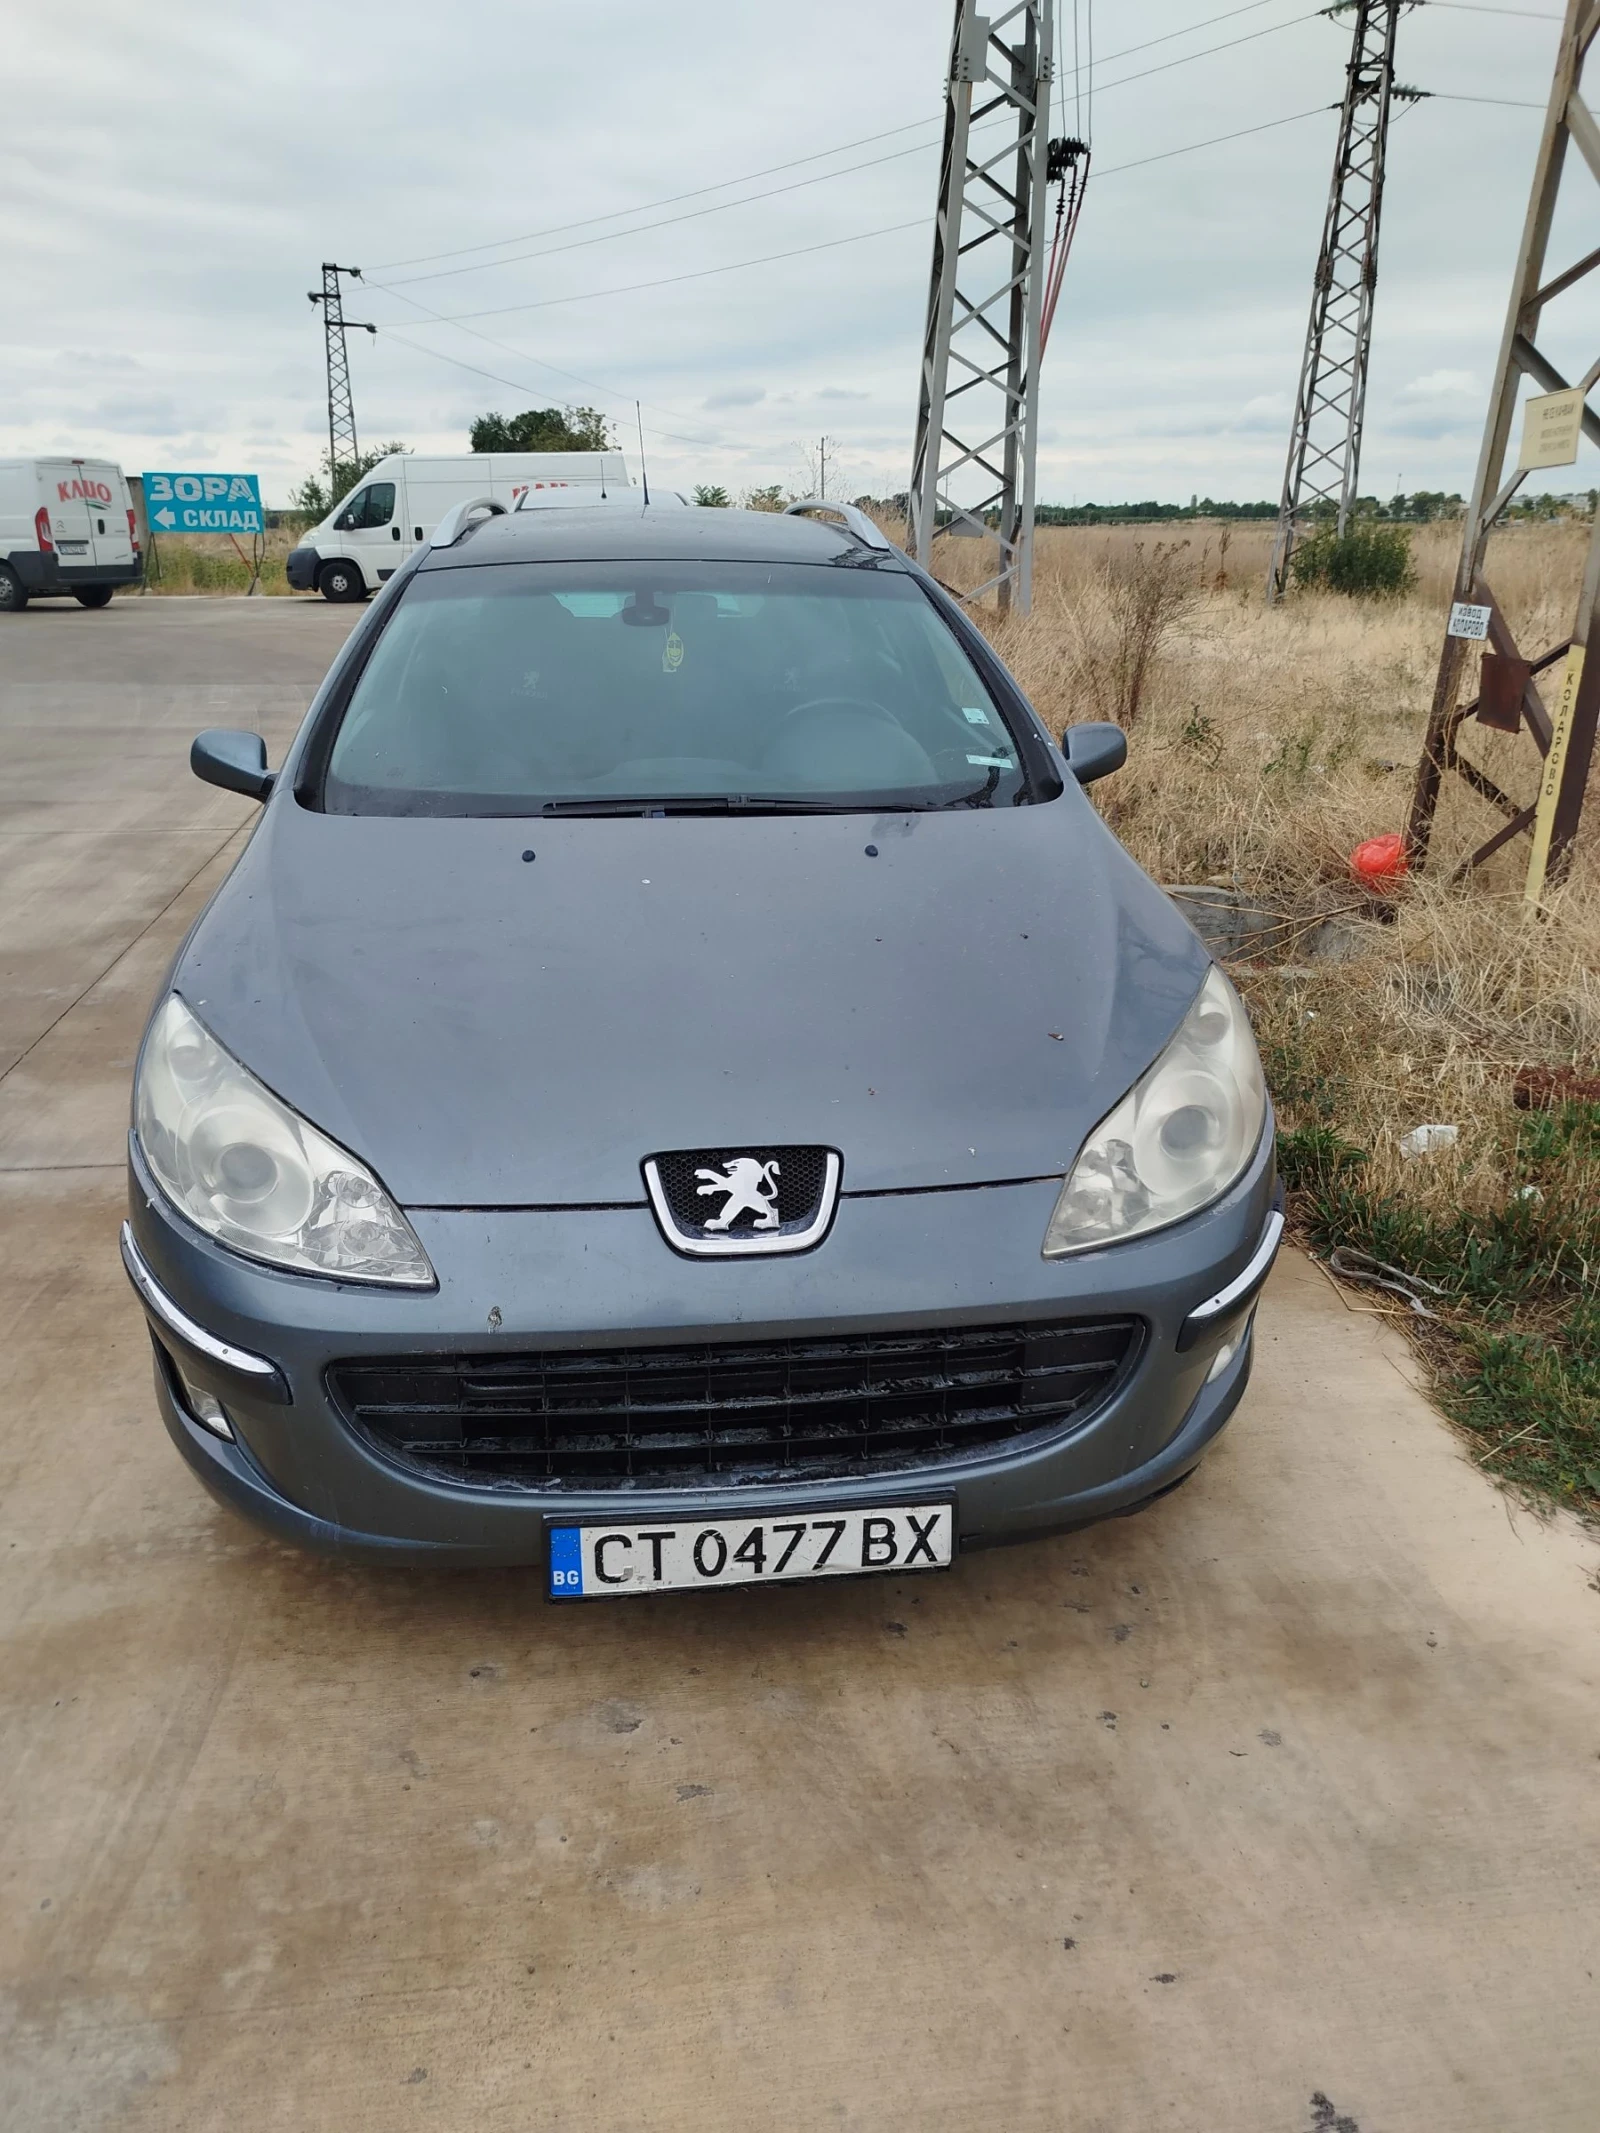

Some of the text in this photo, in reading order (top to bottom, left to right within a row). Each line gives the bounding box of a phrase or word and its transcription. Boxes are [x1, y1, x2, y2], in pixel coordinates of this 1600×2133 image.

[150, 475, 256, 502] ЗОРА
[183, 509, 260, 530] СКЛАД
[1545, 672, 1574, 796] КОЛАРОВО
[594, 1514, 942, 1584] CT 0477 BX
[552, 1570, 580, 1586] BG
